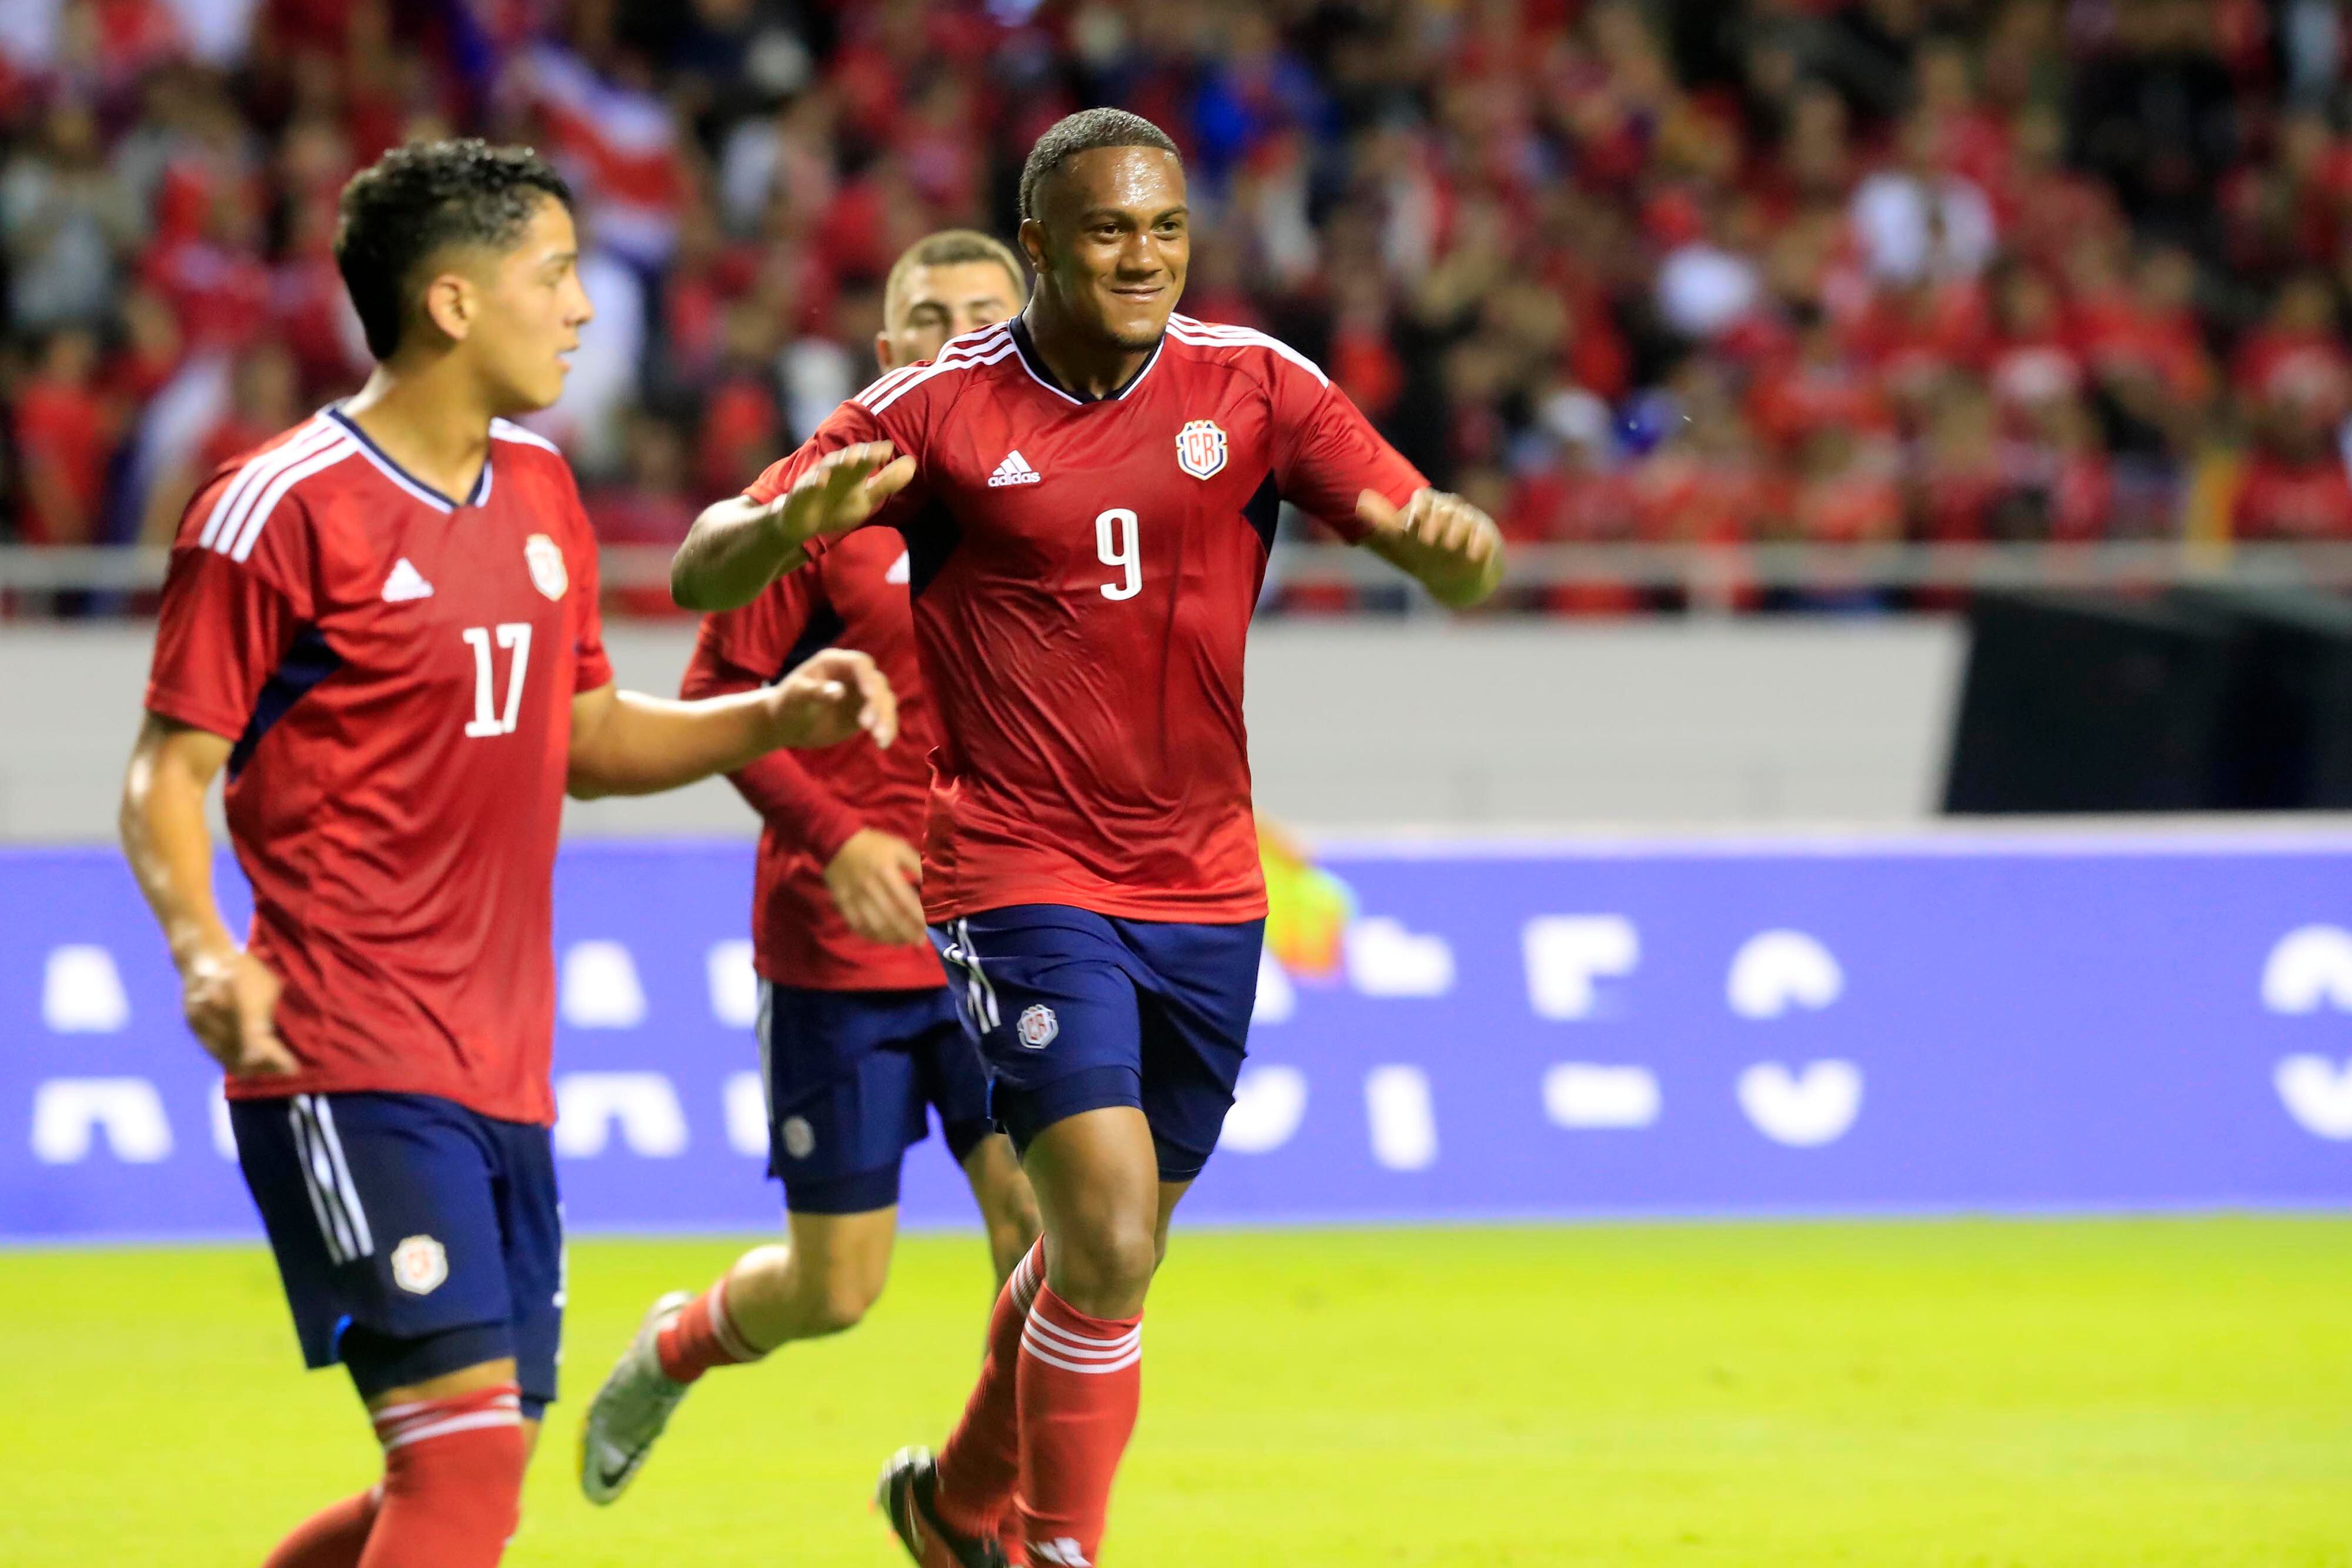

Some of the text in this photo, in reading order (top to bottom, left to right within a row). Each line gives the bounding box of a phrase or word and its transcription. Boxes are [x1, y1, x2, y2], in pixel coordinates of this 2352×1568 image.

[988, 471, 1041, 487] adidas
[1188, 432, 1215, 466] CR
[1095, 508, 1142, 601] 9
[462, 622, 533, 738] 17
